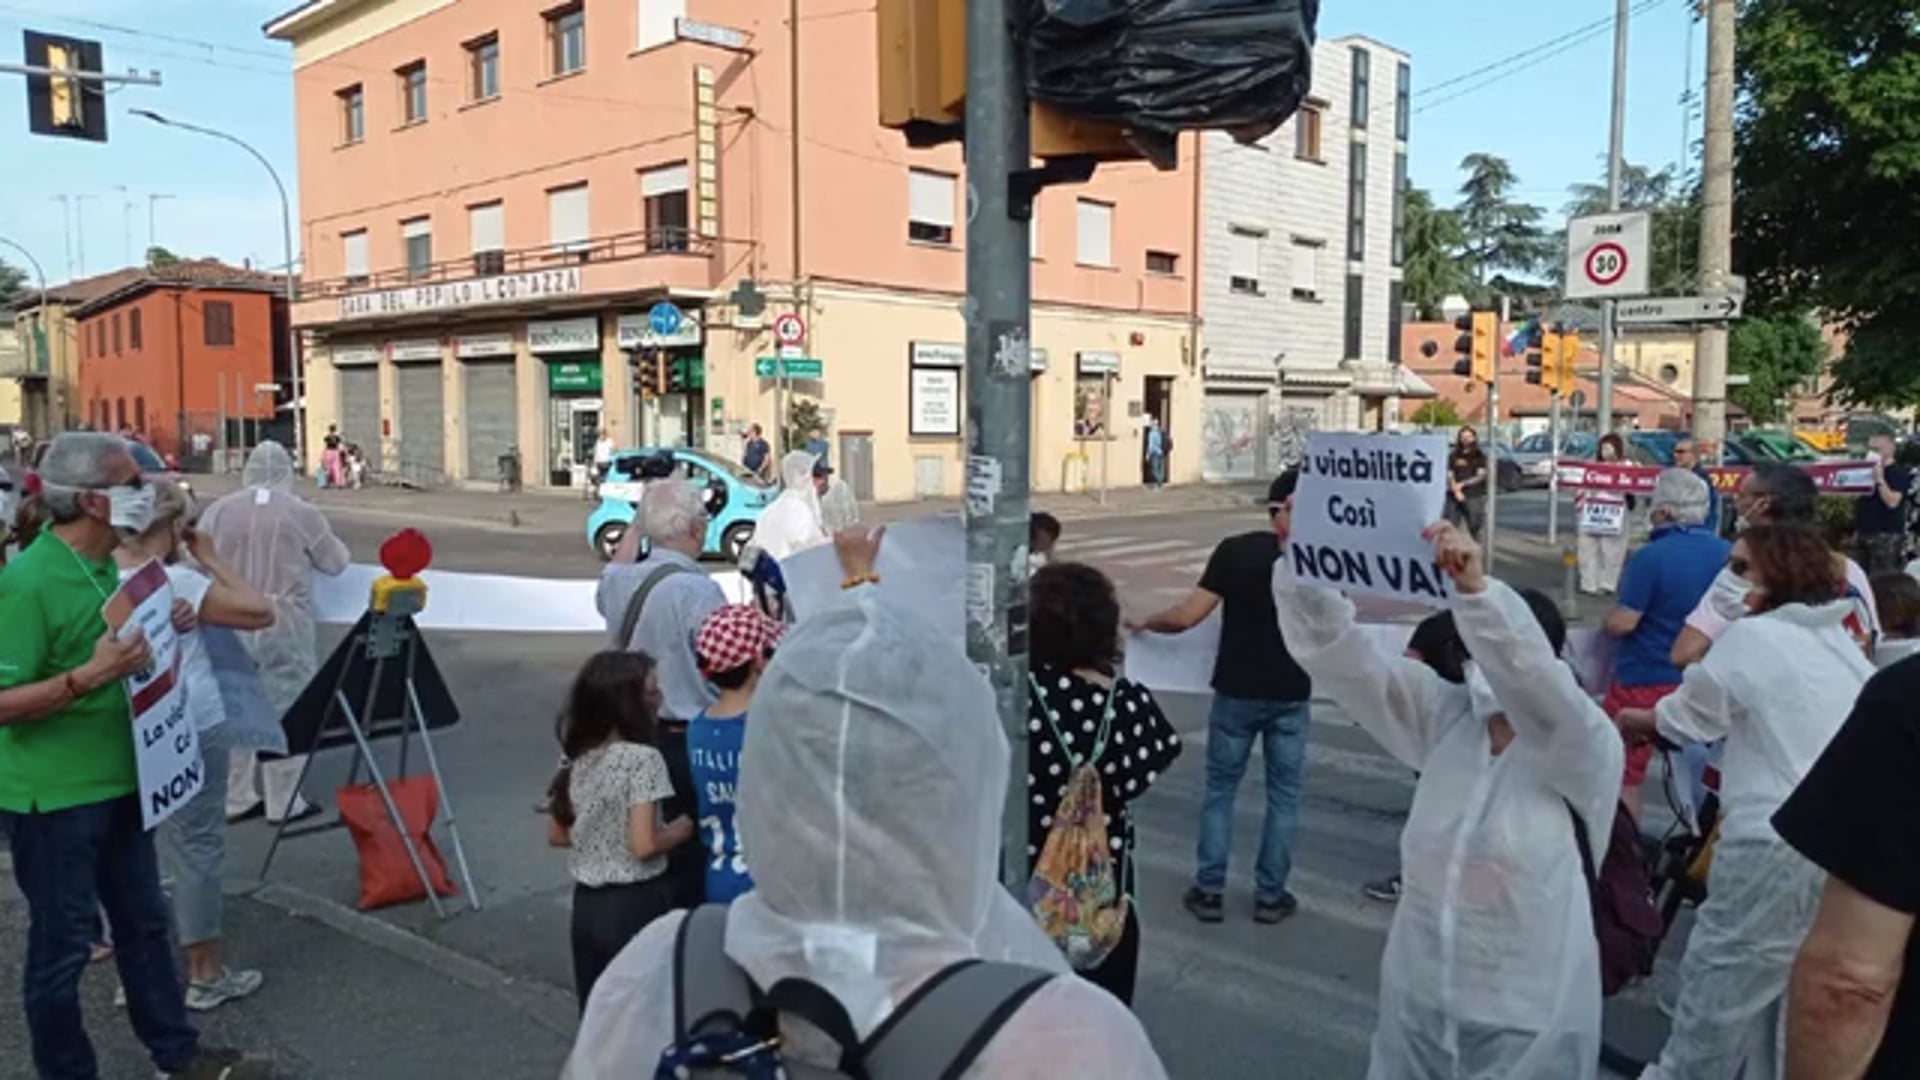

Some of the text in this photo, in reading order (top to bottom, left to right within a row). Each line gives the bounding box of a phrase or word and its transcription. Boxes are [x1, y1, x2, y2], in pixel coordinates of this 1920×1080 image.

[1595, 254, 1618, 274] 30
[381, 292, 406, 311] DEL
[1619, 305, 1664, 317] centro
[1315, 446, 1433, 484] viabilità
[1327, 493, 1378, 528] Così
[1292, 542, 1447, 599] NON VA!
[142, 726, 166, 749] La
[151, 761, 201, 815] NON
